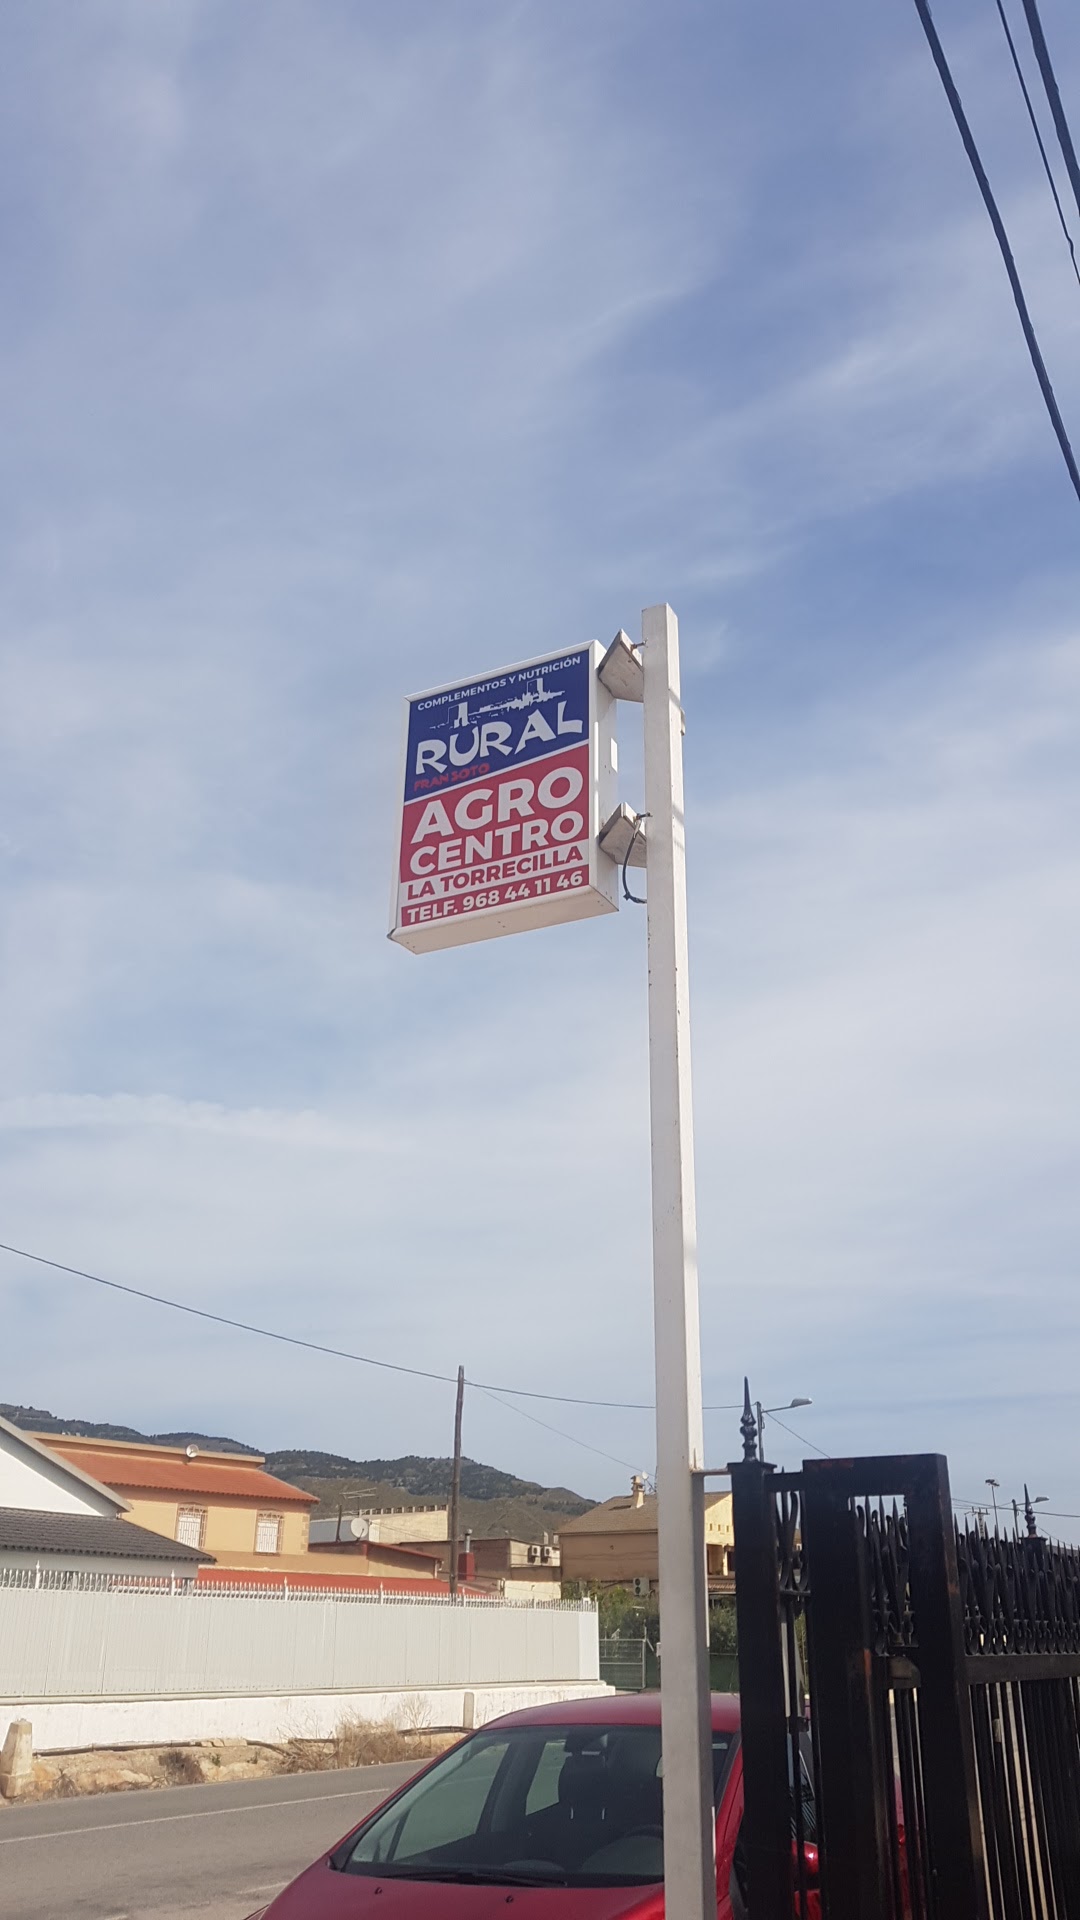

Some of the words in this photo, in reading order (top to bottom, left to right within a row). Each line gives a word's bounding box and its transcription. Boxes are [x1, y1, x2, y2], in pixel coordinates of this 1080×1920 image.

[417, 678, 506, 711] COMPLEMENTOS
[509, 676, 516, 684] Y
[518, 656, 581, 682] NUTRICIÓN
[415, 701, 583, 775] RURAL
[414, 774, 449, 792] FRAN
[452, 763, 490, 782] SOTO
[410, 767, 583, 844] AGRO
[410, 811, 583, 875] CENTRO
[407, 881, 433, 900] LA
[440, 846, 583, 892] TORRECILLA
[407, 903, 458, 923] TELF.
[463, 890, 500, 912] 968
[505, 884, 530, 901] 44
[534, 877, 551, 894] 11
[556, 870, 583, 888] 46
